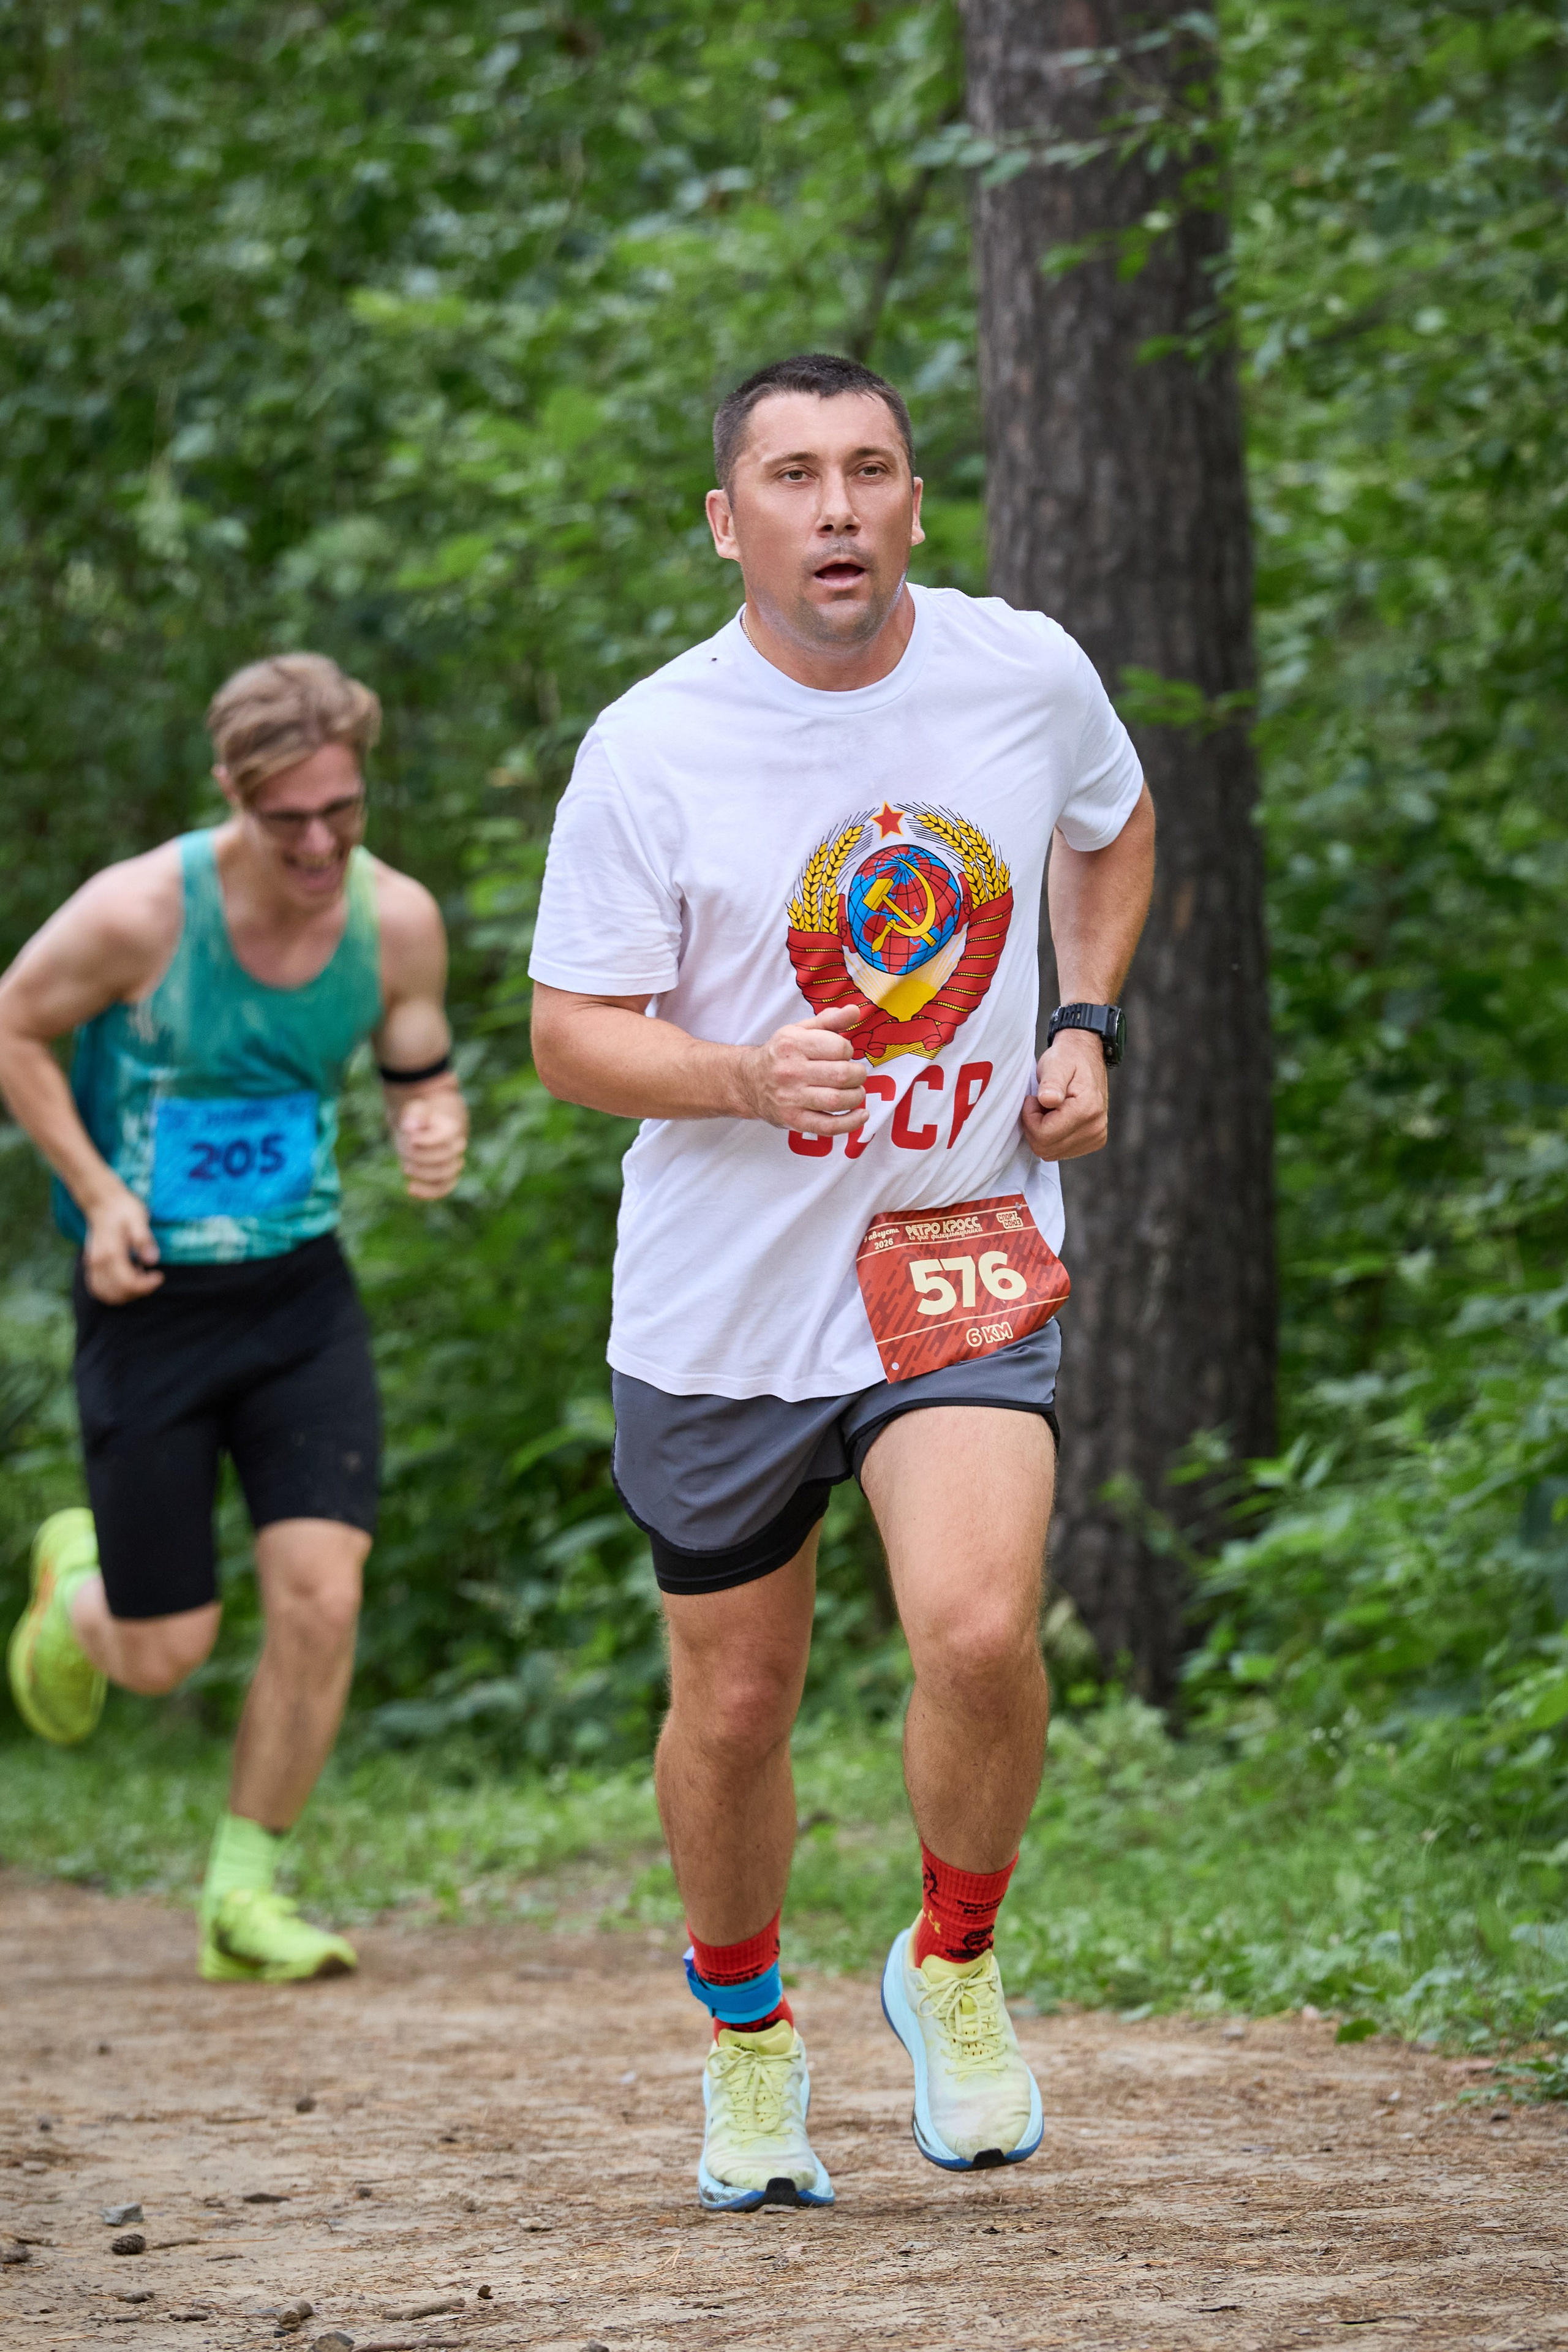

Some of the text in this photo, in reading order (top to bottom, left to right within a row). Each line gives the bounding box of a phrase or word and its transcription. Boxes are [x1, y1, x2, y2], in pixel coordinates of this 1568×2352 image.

[188, 1133, 288, 1181] 205
[998, 1213, 1016, 1221] СПОРТ
[1004, 1219, 1022, 1227] СОЮЗ
[869, 1228, 900, 1239] августа
[905, 1216, 981, 1236] РЕТРО КРОСС
[875, 1237, 894, 1250] 2026
[909, 1251, 1027, 1316] 576
[966, 1327, 982, 1348] 6
